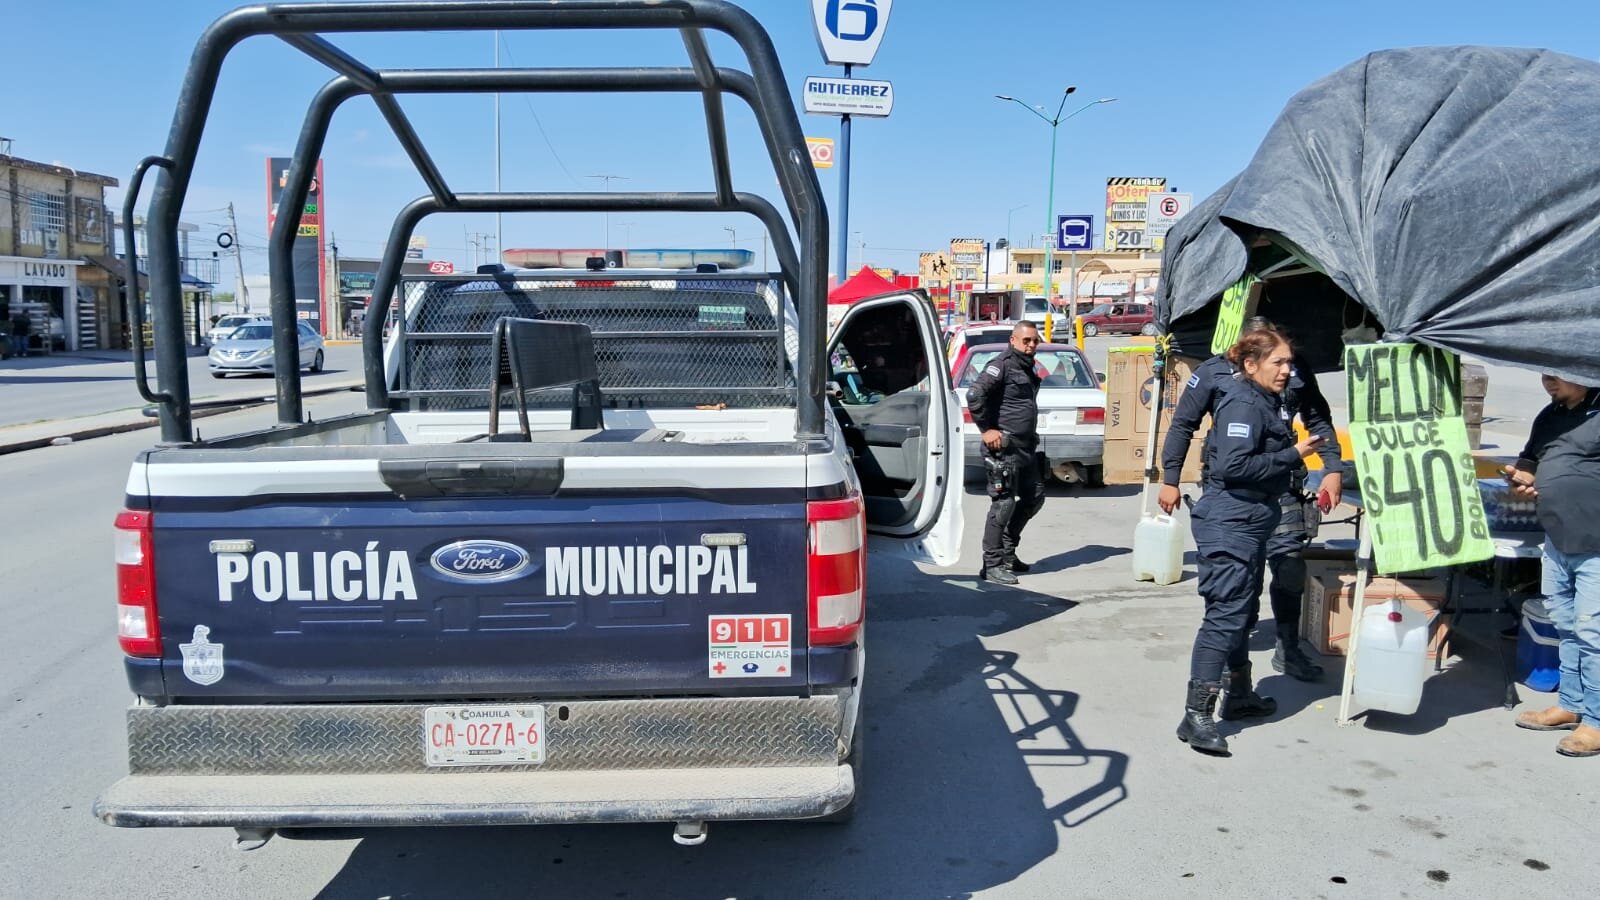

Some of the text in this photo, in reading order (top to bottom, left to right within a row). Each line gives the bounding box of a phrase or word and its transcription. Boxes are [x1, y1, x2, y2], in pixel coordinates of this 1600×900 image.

[808, 82, 889, 97] GUTIERREZ
[1113, 210, 1130, 220] VINOS
[1132, 210, 1136, 220] Y
[1108, 230, 1142, 245] $ 20
[24, 262, 65, 277] LAVADO
[1347, 343, 1462, 425] MELON
[1111, 400, 1121, 427] TAPA
[1366, 421, 1445, 451] DULCE
[1460, 452, 1488, 541] BOLSA
[453, 549, 505, 570] Ford
[545, 545, 756, 597] MUNICIPAL
[217, 541, 418, 602] POLICÍA
[711, 650, 789, 660] EMERGENCIAS
[460, 709, 510, 720] COAHUILA
[432, 722, 538, 747] CA-027A-6
